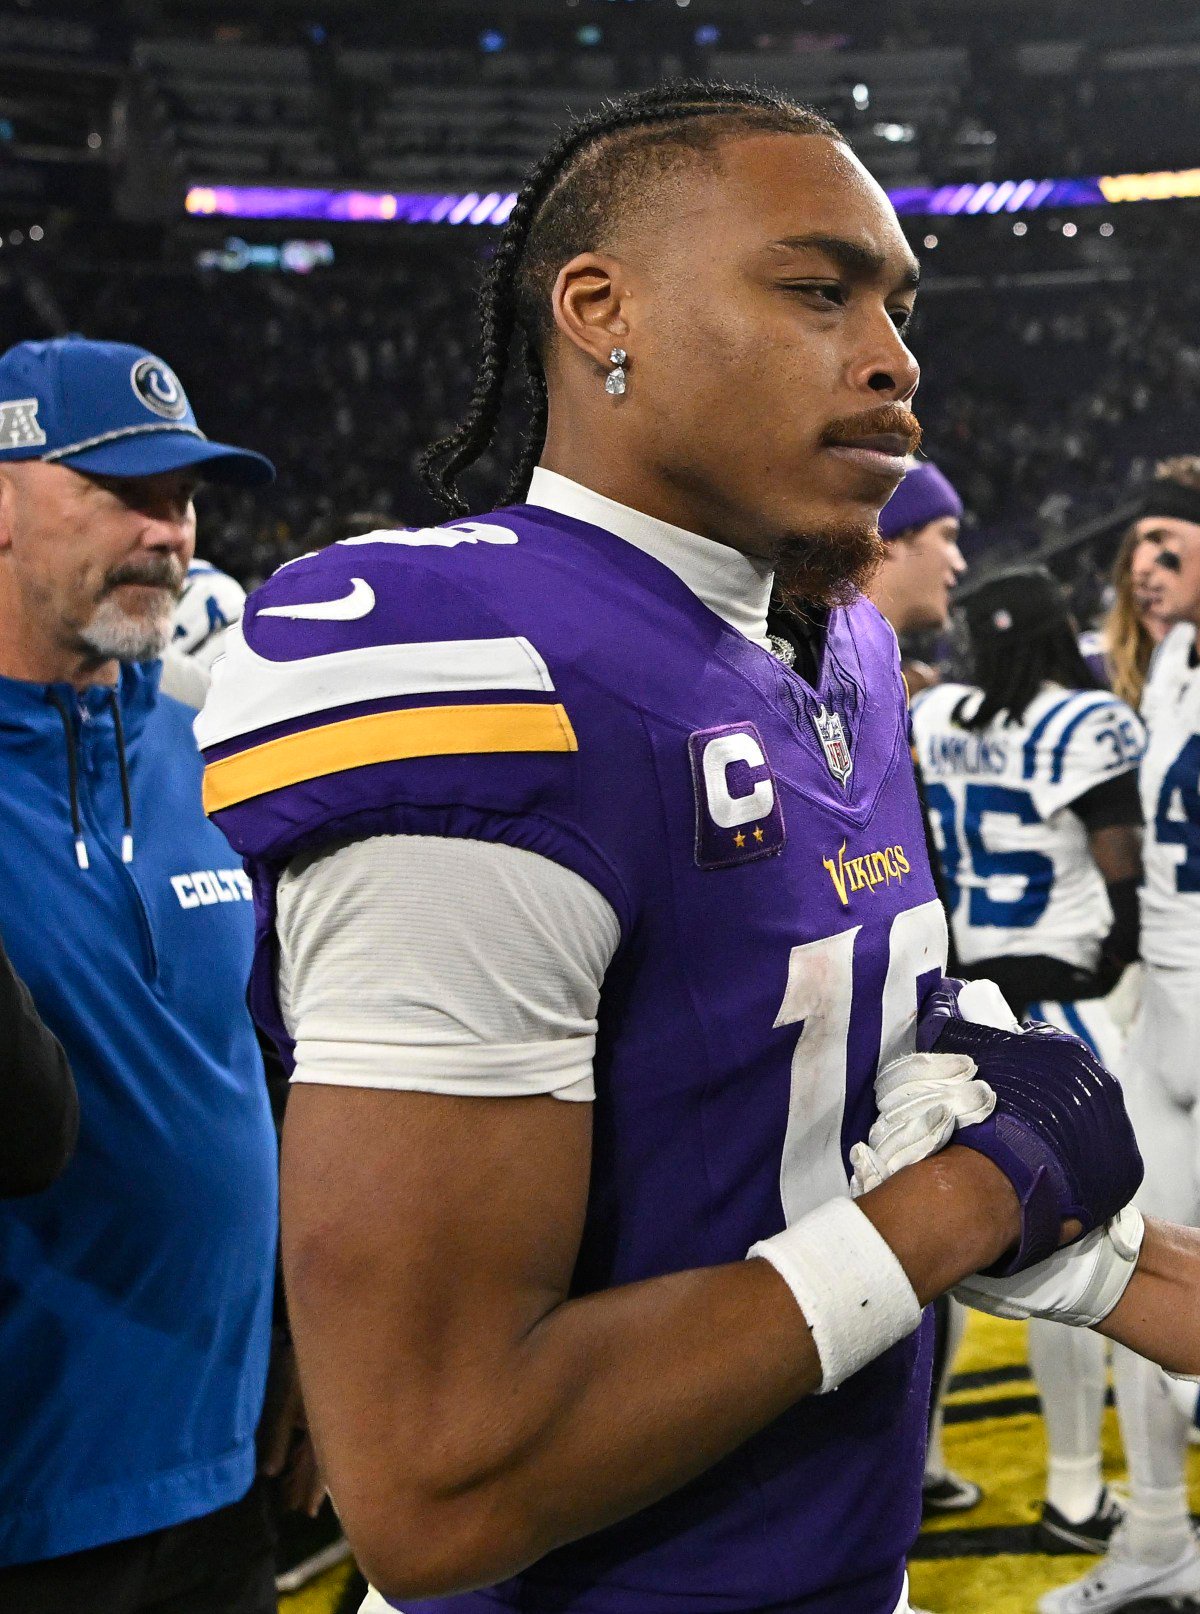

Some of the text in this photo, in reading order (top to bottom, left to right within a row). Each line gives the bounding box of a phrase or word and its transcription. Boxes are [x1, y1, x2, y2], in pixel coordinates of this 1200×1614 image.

[702, 731, 775, 829] C
[826, 740, 849, 773] NFL
[170, 868, 253, 910] COLTS
[822, 836, 911, 905] VIKINGS
